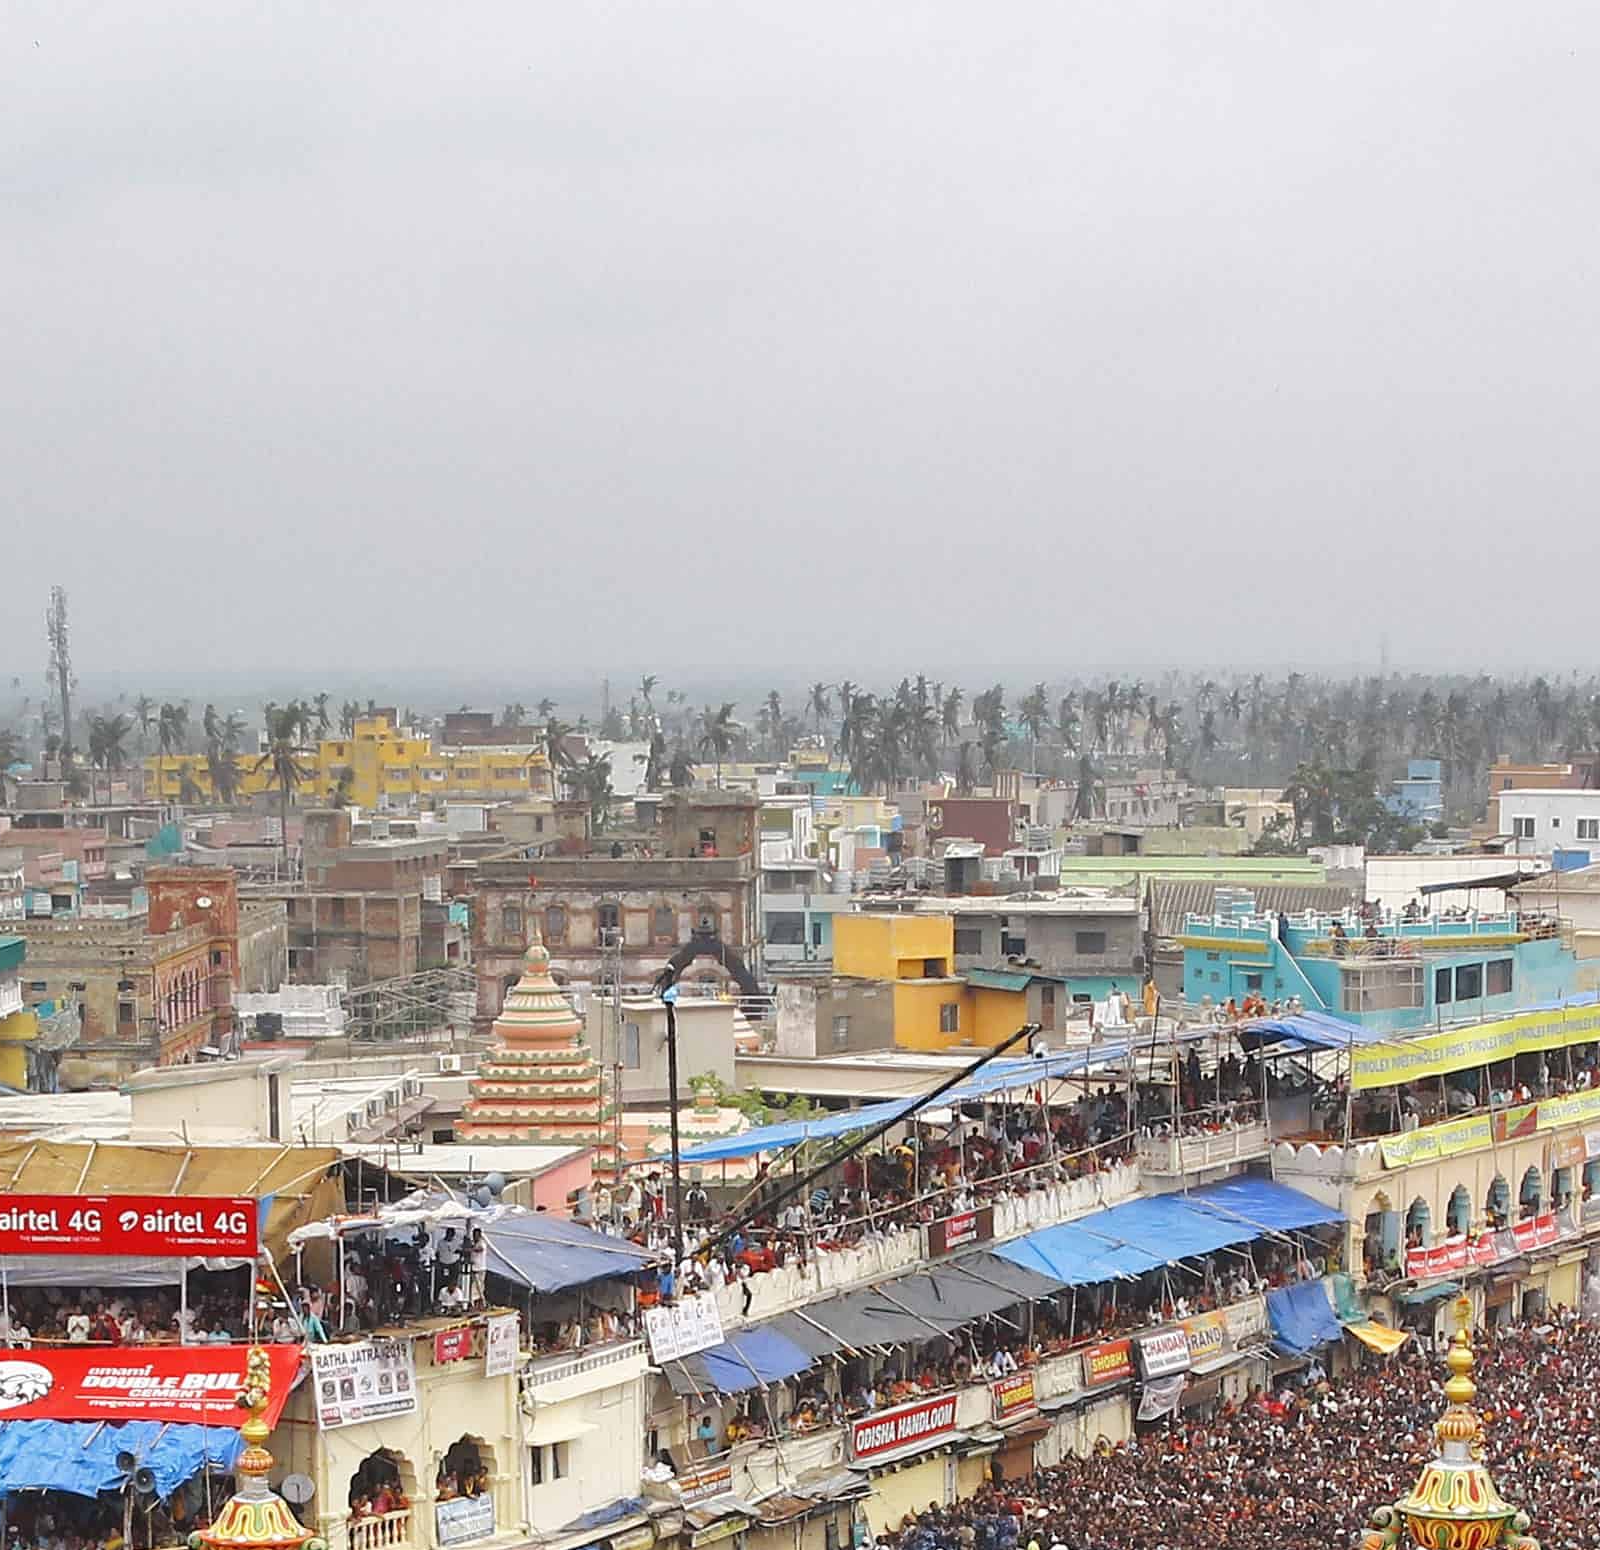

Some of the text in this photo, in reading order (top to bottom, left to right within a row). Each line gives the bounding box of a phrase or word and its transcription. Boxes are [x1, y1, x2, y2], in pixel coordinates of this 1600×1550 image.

[68, 1210, 102, 1231] 4G
[143, 1209, 203, 1233] airtel
[214, 1212, 247, 1233] 4G
[1142, 1335, 1185, 1356] CHANDAN
[316, 1353, 348, 1368] RATHA
[351, 1347, 381, 1363] JATRA
[81, 1375, 180, 1389] DOUBLE
[129, 1388, 207, 1398] CEMENT
[856, 1403, 953, 1452] ODISHA HANDLOOM
